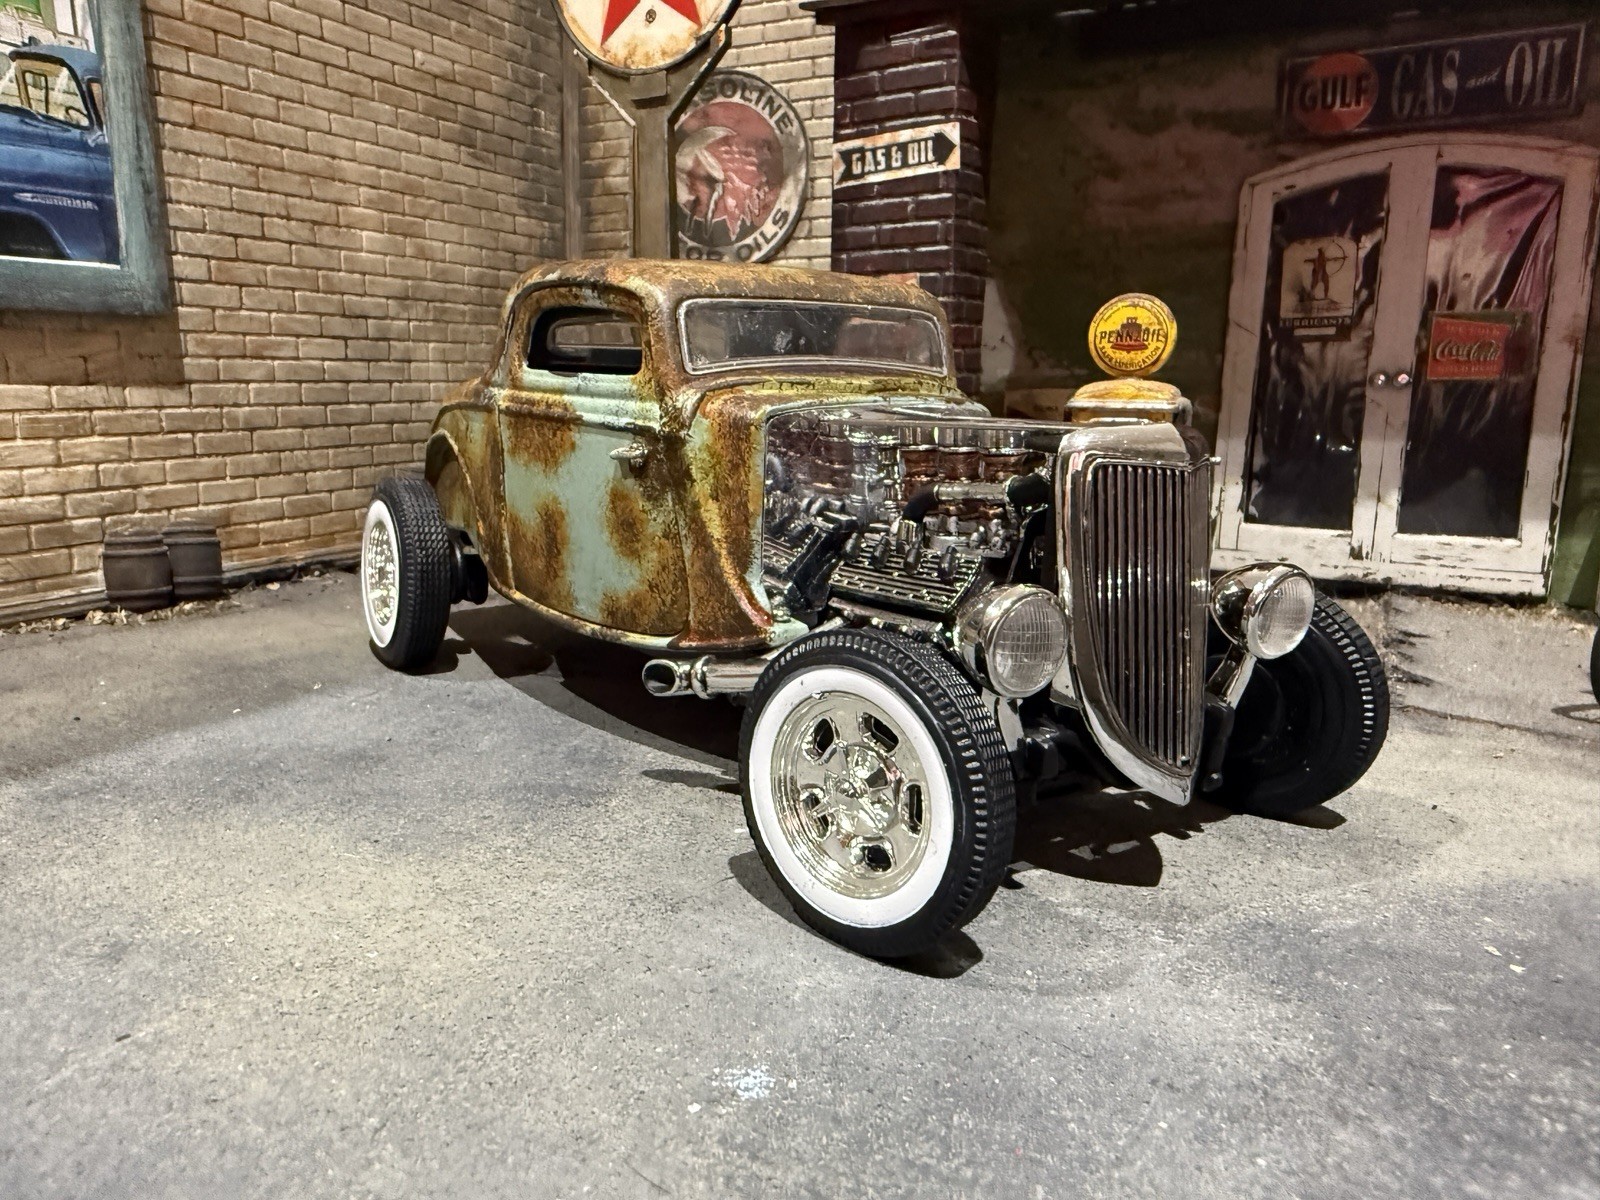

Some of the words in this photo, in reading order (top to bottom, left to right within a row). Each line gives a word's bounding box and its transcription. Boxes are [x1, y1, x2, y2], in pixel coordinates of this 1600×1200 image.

[692, 77, 793, 134] SOLINE
[1304, 71, 1371, 110] GULF
[1391, 50, 1460, 117] GAS
[1466, 68, 1499, 88] and
[1506, 38, 1567, 106] OIL
[852, 148, 886, 174] GAS
[891, 145, 902, 168] &
[908, 140, 936, 165] OIL
[735, 207, 790, 262] OILS
